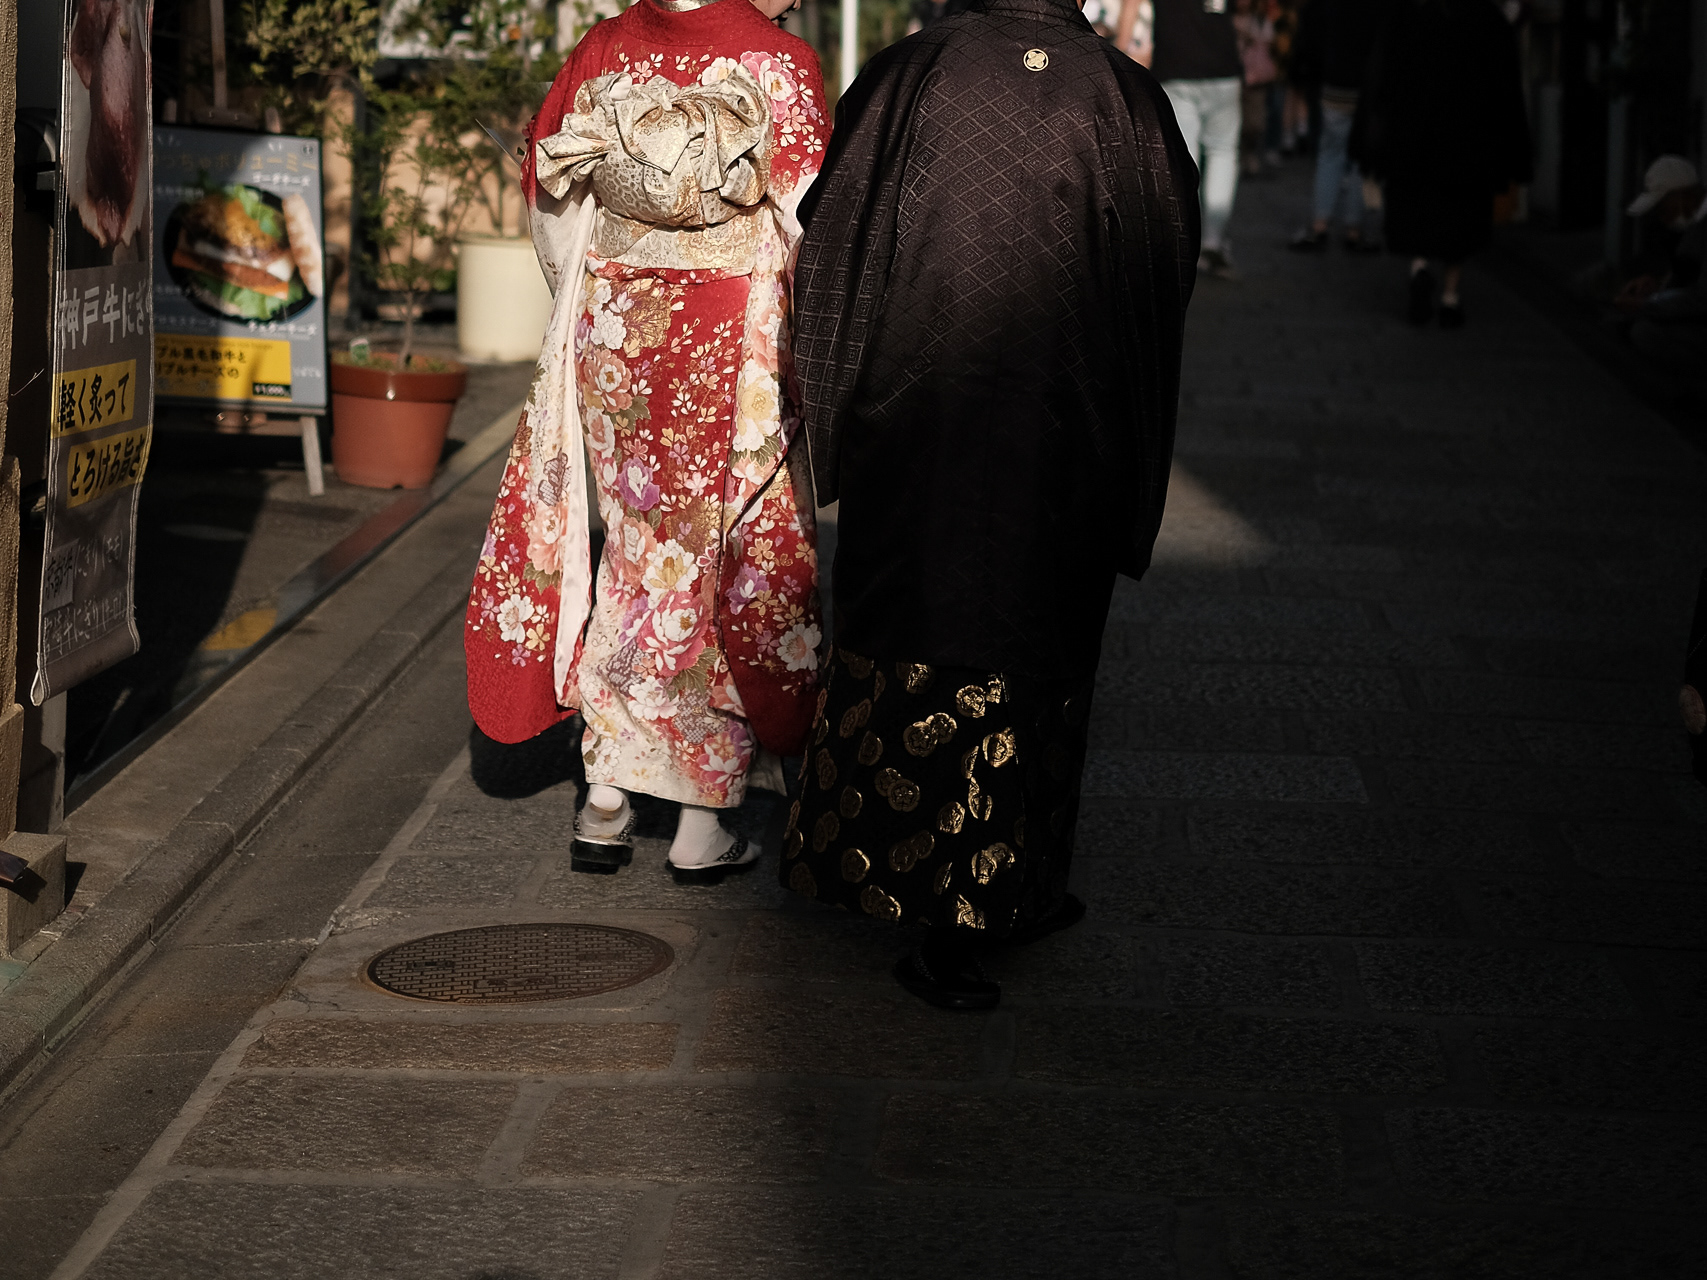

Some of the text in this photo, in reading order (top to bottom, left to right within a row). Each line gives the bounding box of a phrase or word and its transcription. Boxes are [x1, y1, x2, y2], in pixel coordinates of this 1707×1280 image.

[57, 373, 129, 431] 軽く炙って
